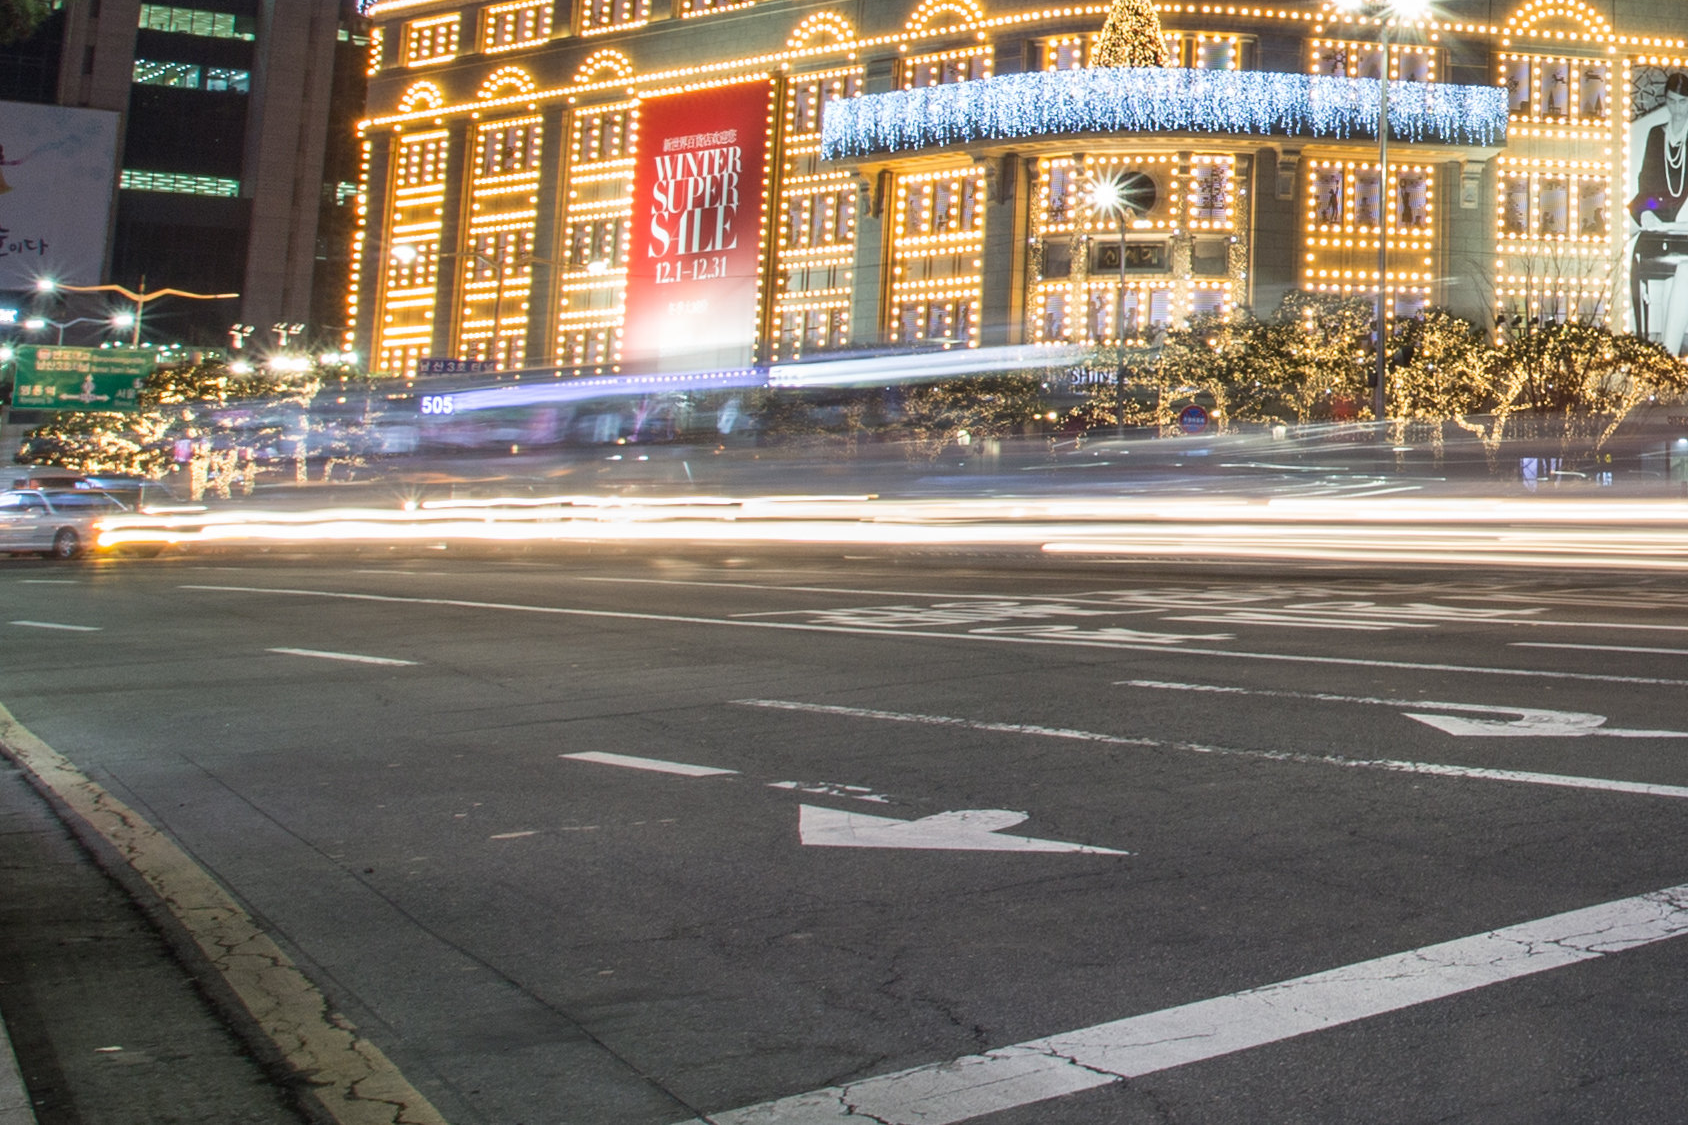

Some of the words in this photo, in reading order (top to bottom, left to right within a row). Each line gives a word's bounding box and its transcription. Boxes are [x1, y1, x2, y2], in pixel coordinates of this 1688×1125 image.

[654, 146, 743, 182] WINTER
[651, 171, 741, 216] SUPER
[648, 203, 738, 258] SALE
[421, 395, 454, 415] 505
